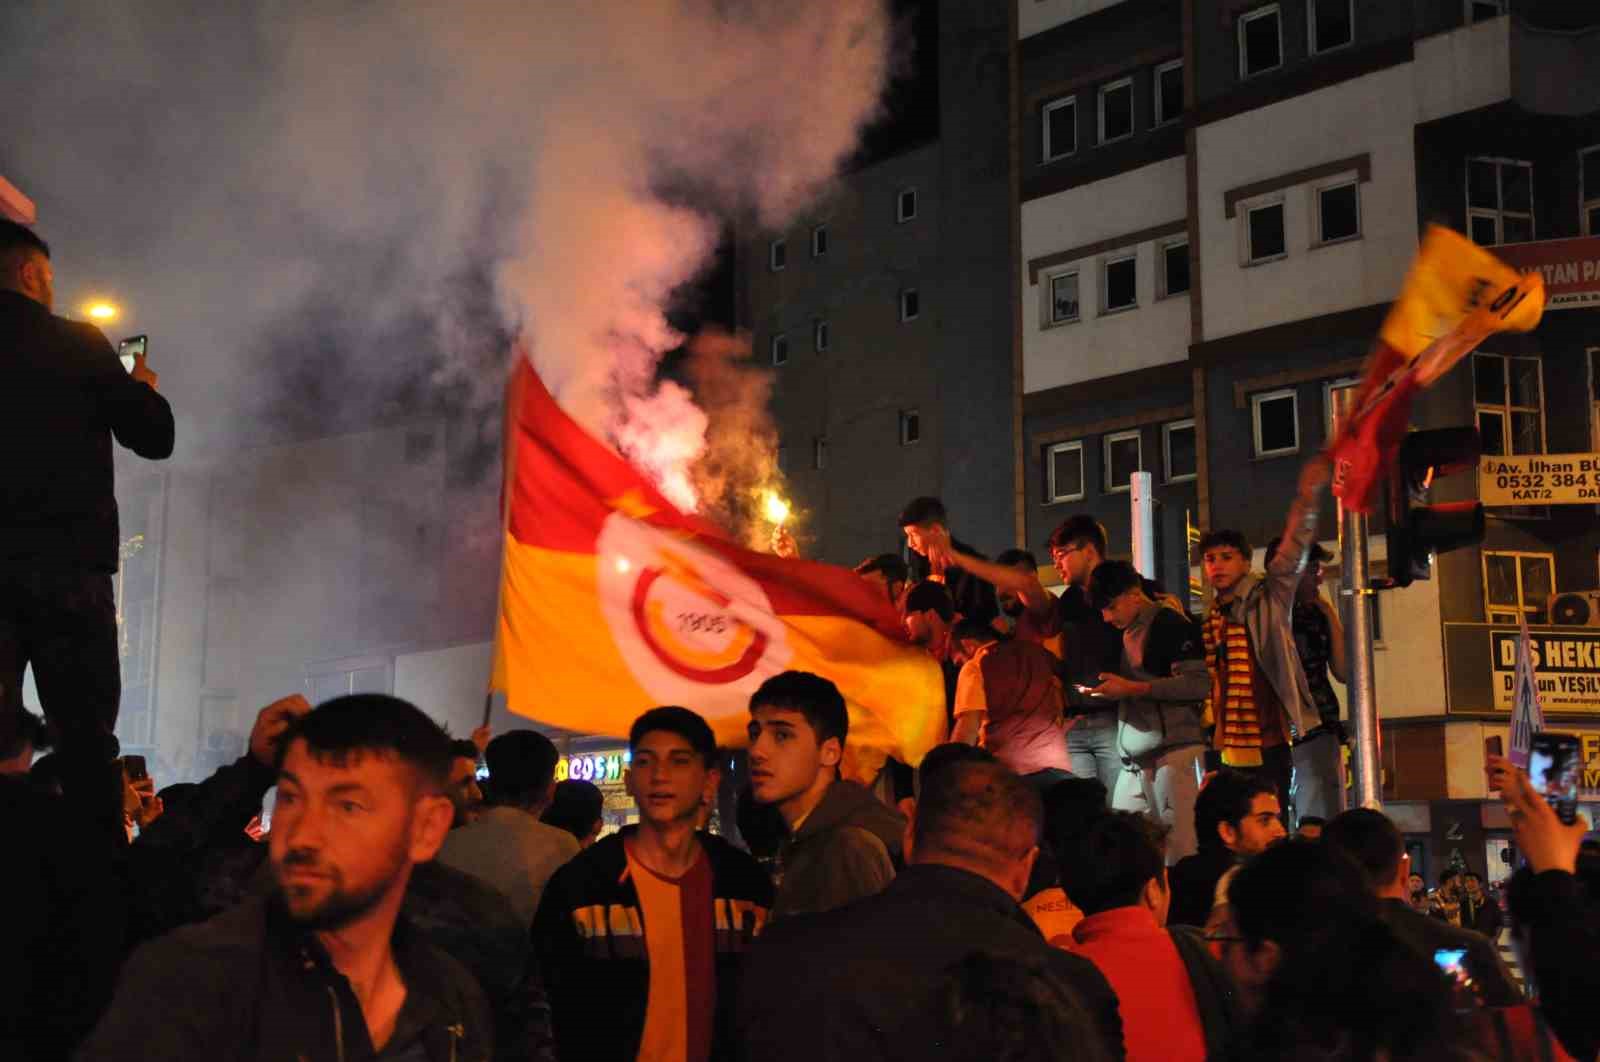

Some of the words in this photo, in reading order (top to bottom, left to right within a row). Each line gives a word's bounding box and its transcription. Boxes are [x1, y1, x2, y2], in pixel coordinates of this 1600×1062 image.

[1497, 463, 1522, 475] Av.
[1529, 458, 1573, 473] İlhan
[1497, 475, 1544, 488] 0532
[1551, 474, 1587, 487] 384
[1512, 489, 1552, 500] KAT/2
